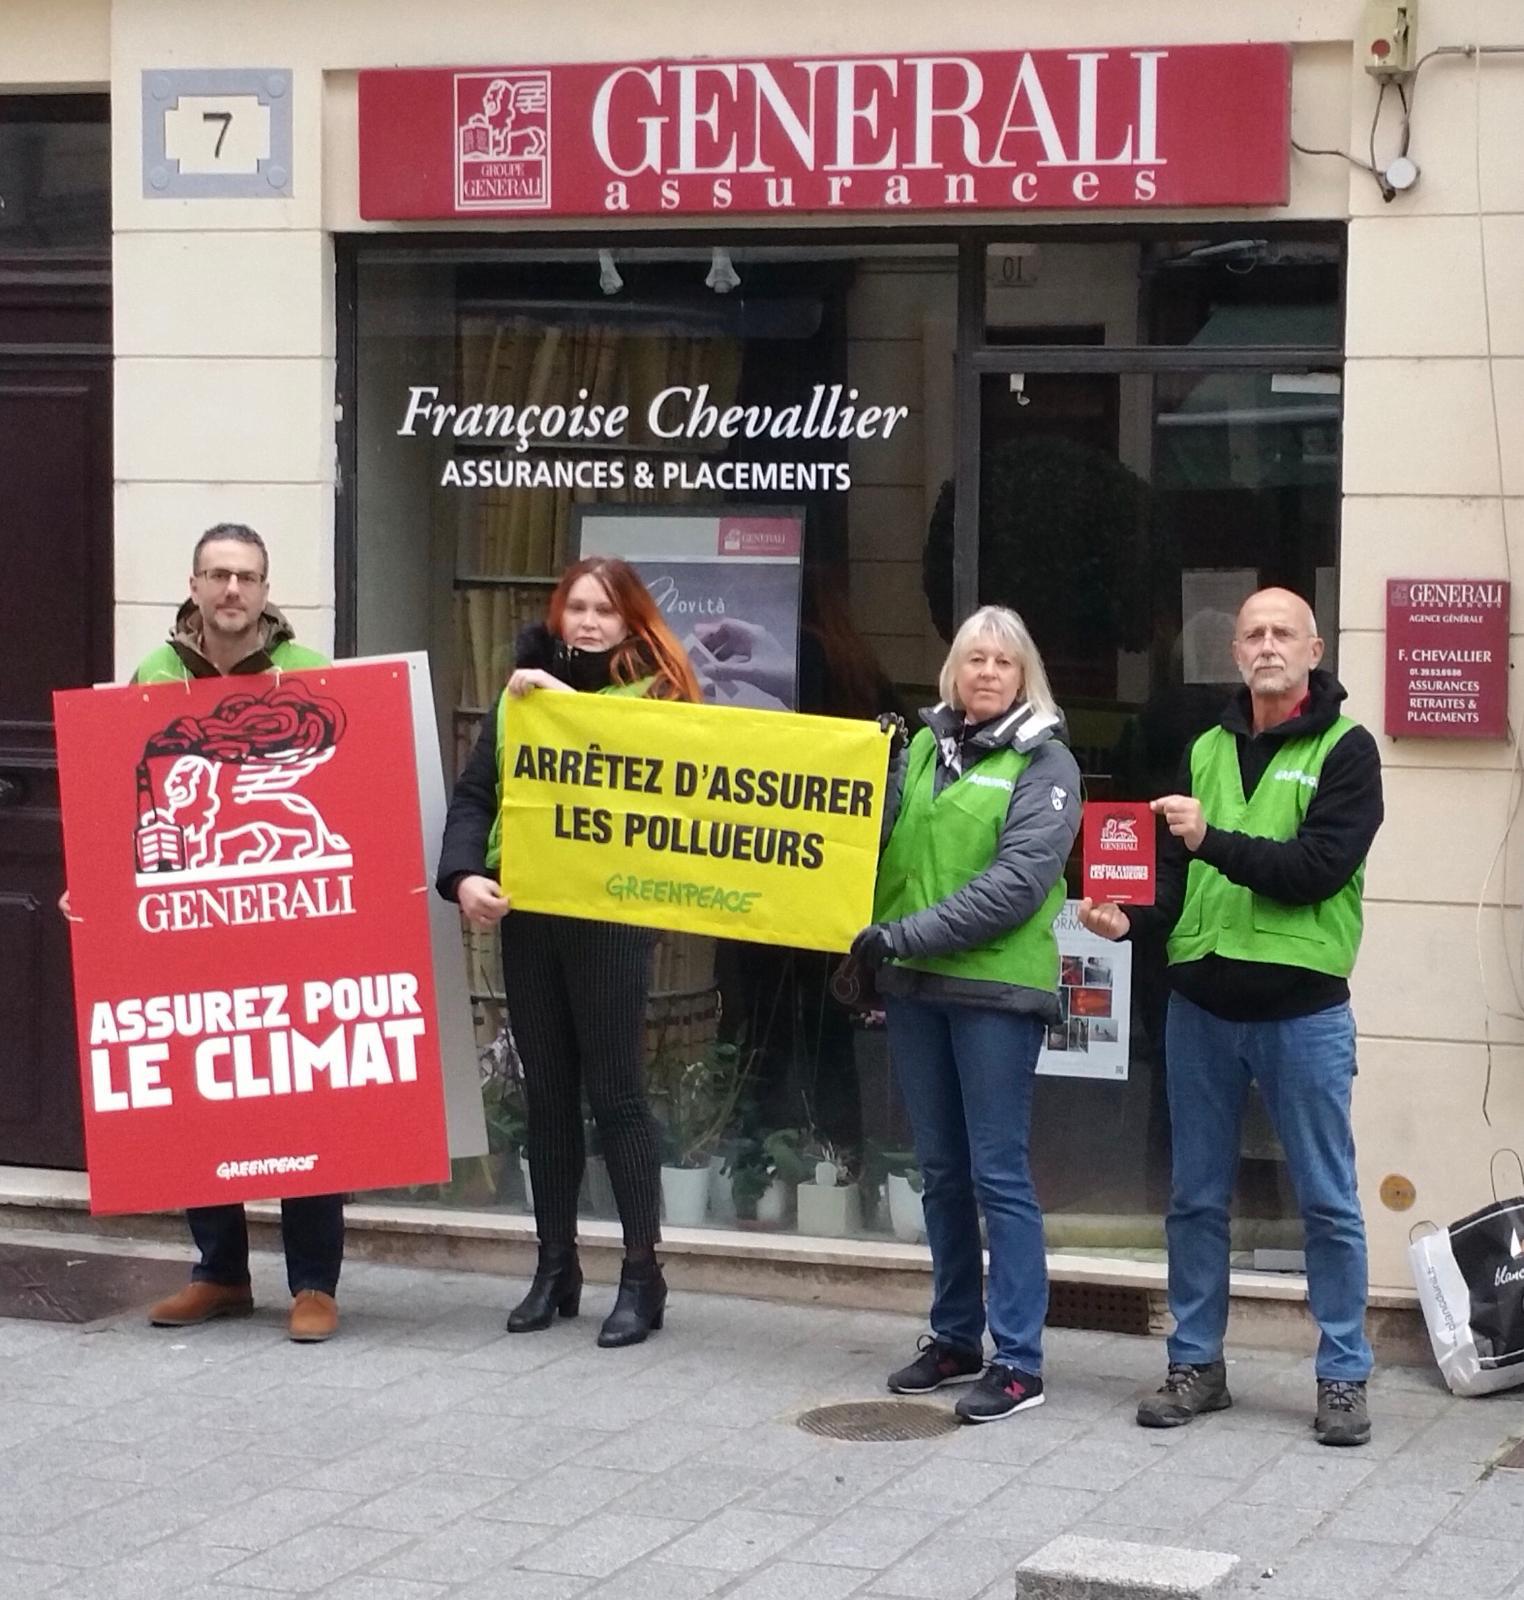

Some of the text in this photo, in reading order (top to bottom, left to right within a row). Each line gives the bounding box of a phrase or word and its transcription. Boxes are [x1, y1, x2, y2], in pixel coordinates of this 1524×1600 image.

[591, 51, 1169, 178] GENERALI
[203, 111, 232, 158] 7
[464, 178, 541, 198] GENERALI
[481, 164, 525, 177] GROUPE
[604, 168, 1158, 211] assurances
[397, 383, 908, 453] Françoise Chevallier
[441, 460, 851, 492] ASSURANCES & PLACEMENTS
[1410, 584, 1503, 604] GENERALI
[1409, 614, 1440, 623] AGENCE
[1398, 648, 1492, 663] F. CHEVALLIER
[1408, 680, 1480, 692] ASSURANCES
[1410, 697, 1478, 710] RETRAITES &
[1407, 711, 1480, 723] PLACEMENTS
[513, 743, 874, 818] ARRÊTEZ D'ASSURER
[554, 804, 825, 870] LES POLLUEURS
[137, 874, 357, 934] GENERALI
[606, 872, 762, 914] GREENPEACE
[90, 972, 423, 1046] ASSUREZ POUR
[91, 1017, 426, 1113] LE CLIMAT
[216, 1153, 319, 1180] GREENPEACE
